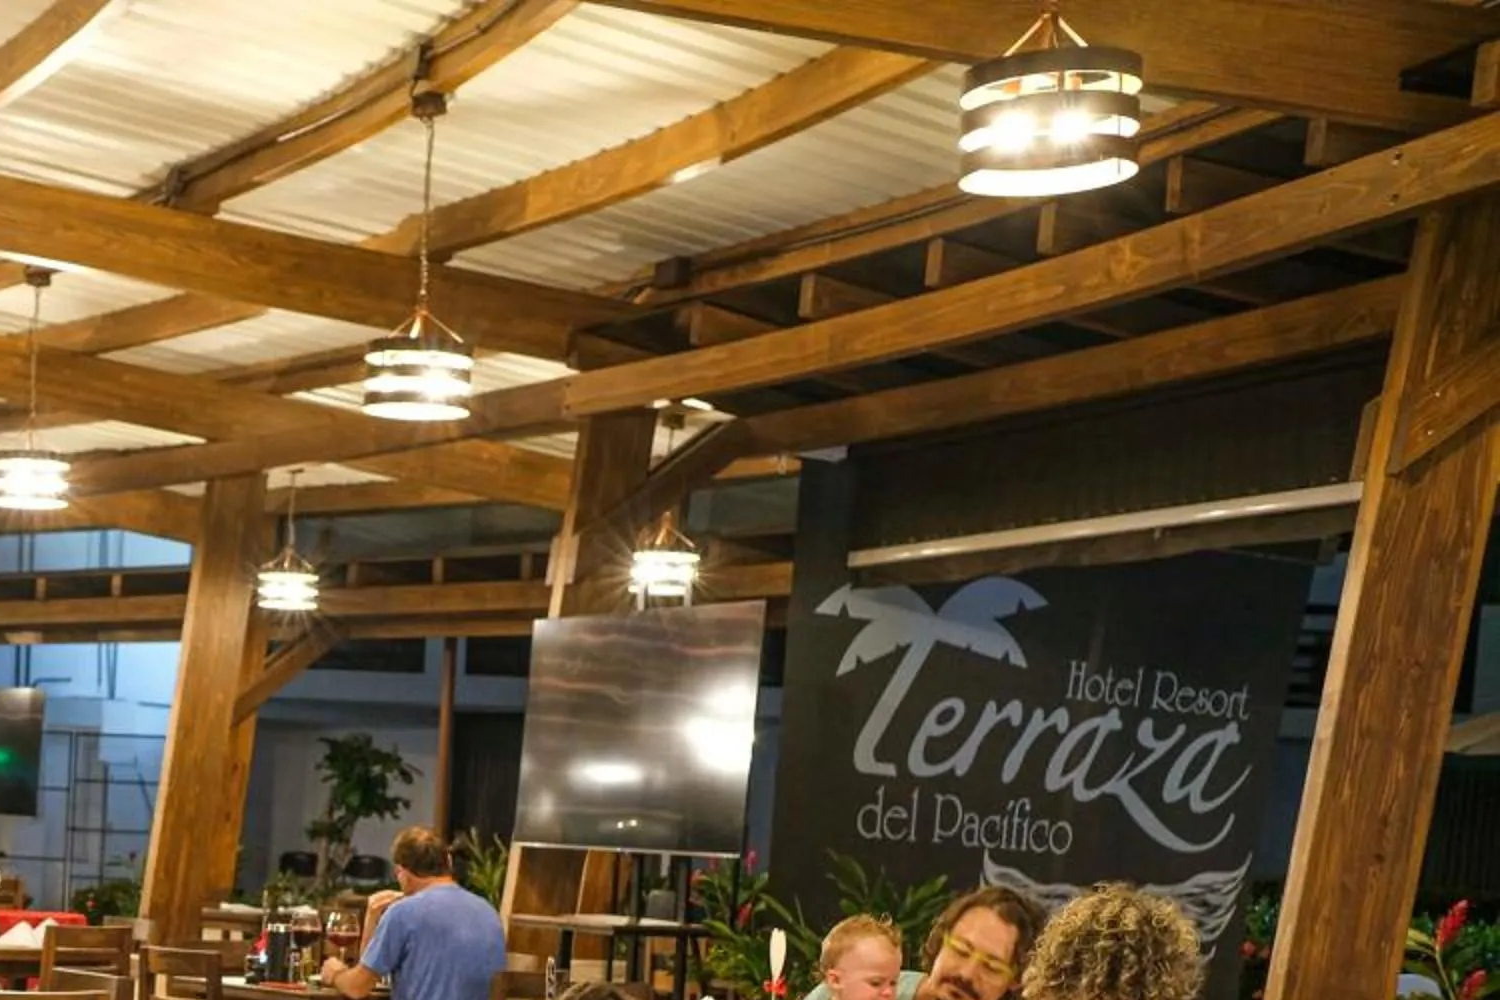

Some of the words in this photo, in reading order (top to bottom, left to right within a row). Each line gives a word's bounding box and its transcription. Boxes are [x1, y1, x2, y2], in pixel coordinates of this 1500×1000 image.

[814, 576, 1253, 853] Terraza
[1065, 660, 1143, 706] Hotel
[1151, 671, 1251, 720] Resort
[857, 785, 918, 842] del
[932, 794, 1073, 854] Pacífico
